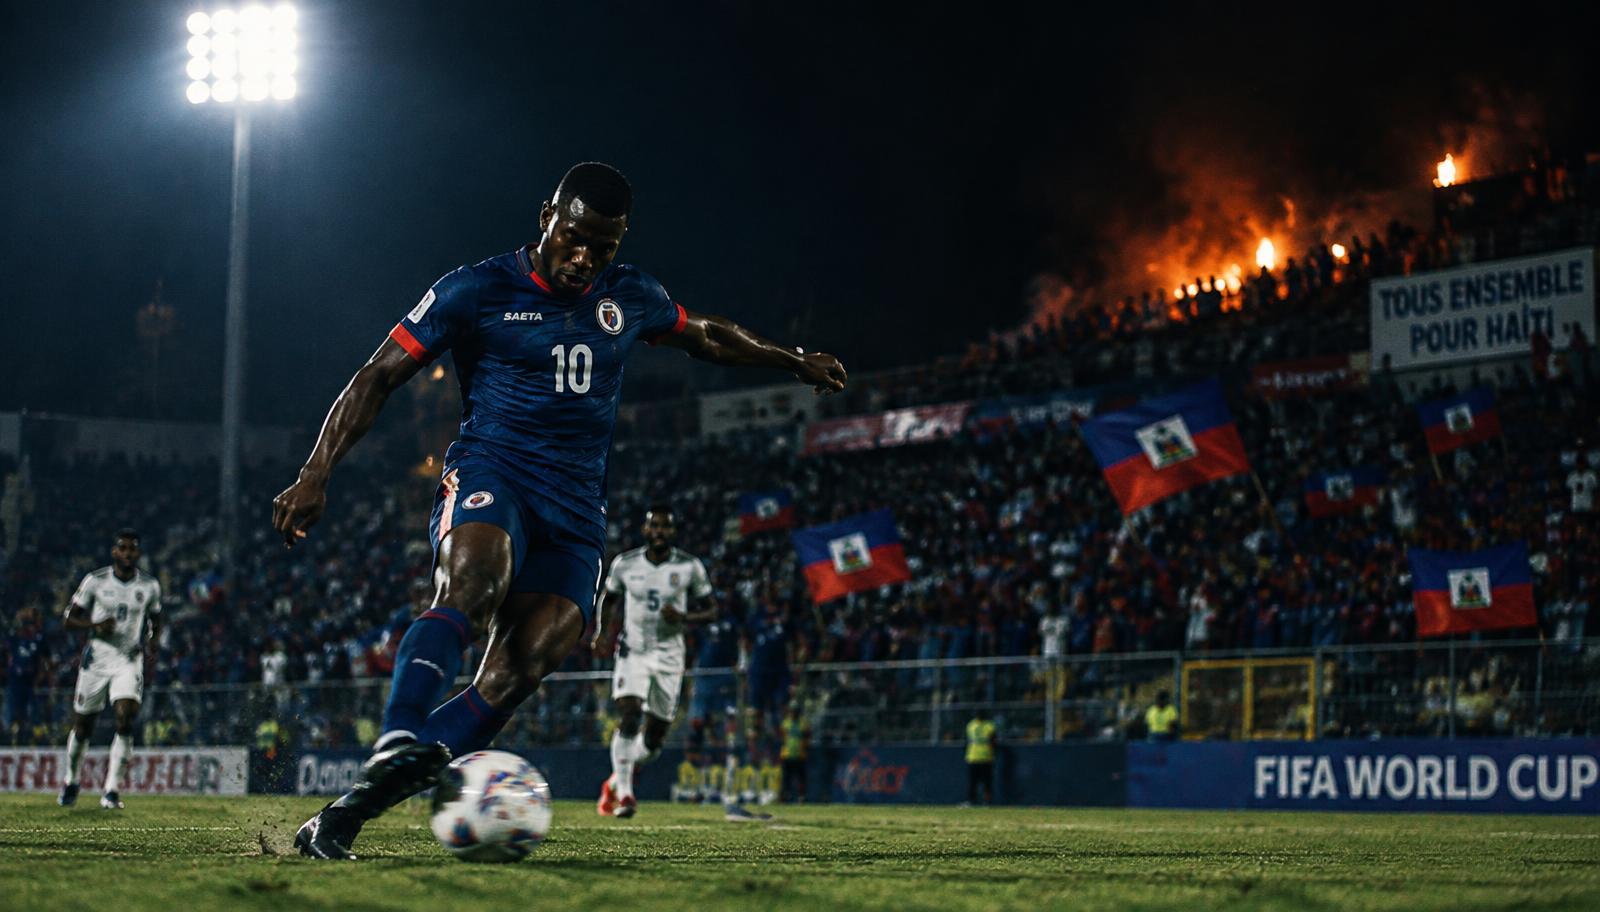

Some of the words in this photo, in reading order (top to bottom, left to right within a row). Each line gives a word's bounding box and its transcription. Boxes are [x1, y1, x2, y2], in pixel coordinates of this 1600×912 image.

[1379, 282, 1442, 320] TOUS
[1450, 260, 1583, 310] ENSEMBLE
[504, 312, 543, 321] SAETA
[1411, 316, 1477, 356] POUR
[1486, 303, 1553, 345] HAÏTI
[551, 343, 593, 394] 10
[647, 590, 659, 611] 5
[1254, 755, 1339, 799] FIFA
[1344, 754, 1500, 800] WORLD
[1506, 754, 1599, 800] CUP
